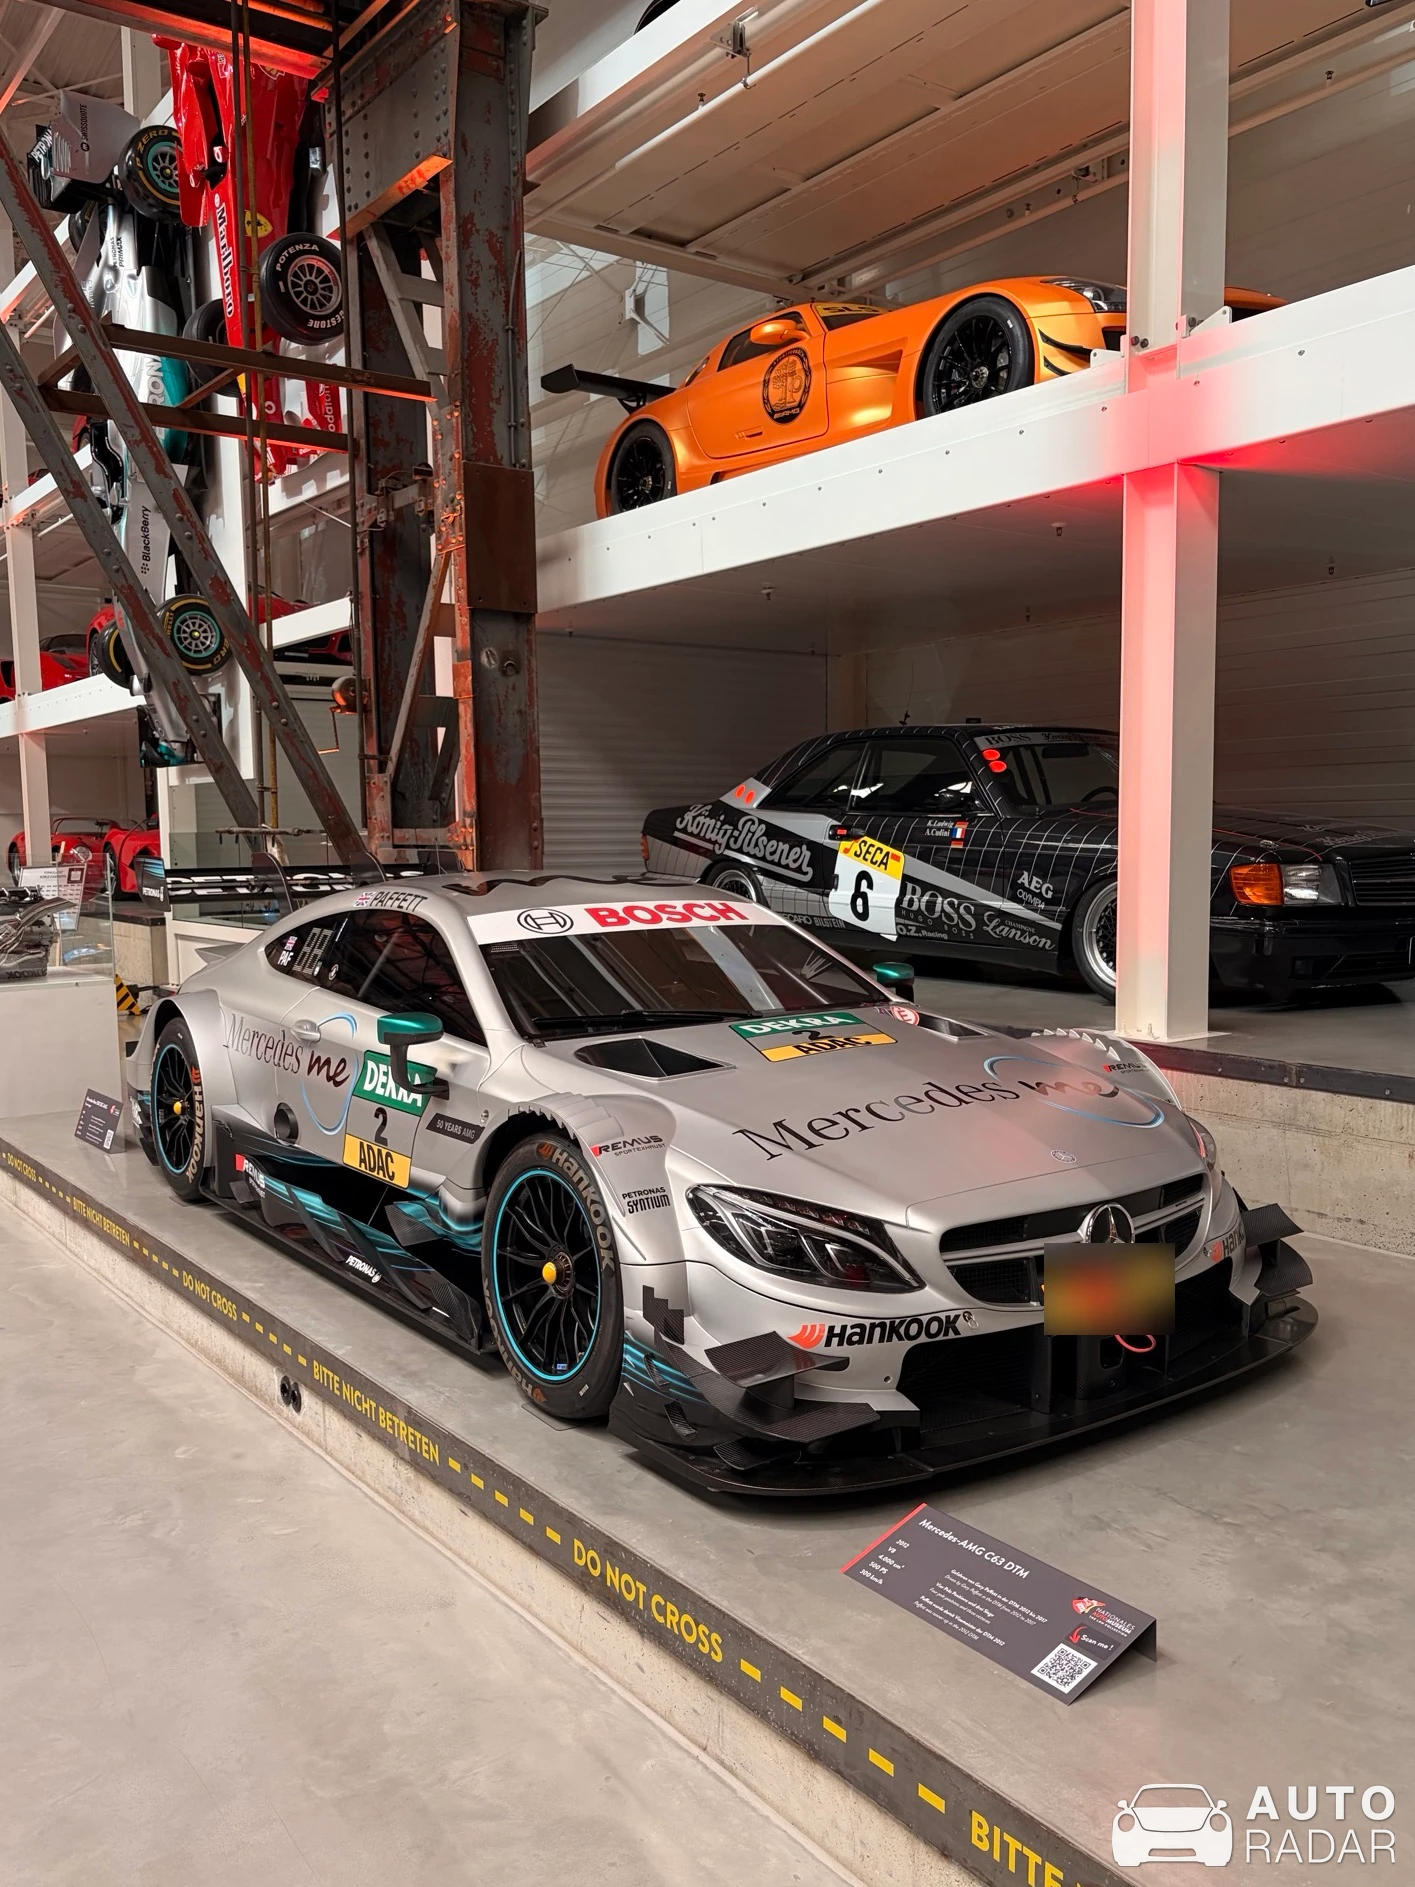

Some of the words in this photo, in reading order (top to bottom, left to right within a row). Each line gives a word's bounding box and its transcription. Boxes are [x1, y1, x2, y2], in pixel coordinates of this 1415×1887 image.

[138, 129, 168, 154] ZERO
[216, 202, 235, 318] Marlboro
[276, 243, 320, 271] POTENZA
[140, 505, 151, 562] BlackBerry
[985, 733, 1031, 746] BOSS
[854, 839, 891, 871] SECA
[142, 886, 160, 898] PETRONAS
[850, 870, 874, 922] 6
[1017, 870, 1053, 899] AEG
[369, 891, 428, 912] PAFFETT
[900, 882, 976, 931] BOSS
[1017, 889, 1046, 910] OLYMPIA
[584, 902, 750, 928] BOSCH
[813, 916, 846, 929] BILSTEIN
[901, 911, 933, 926] HUGO
[944, 925, 974, 940] BOSS
[983, 911, 1056, 950] Lanson
[277, 950, 294, 967] PAF
[739, 1015, 856, 1034] DEKRA
[792, 1030, 833, 1041] 2
[223, 1013, 304, 1074] Mercedes
[307, 1050, 350, 1087] me
[791, 1037, 873, 1055] ADAC
[373, 1107, 389, 1146] 2
[436, 1119, 444, 1129] 50
[444, 1121, 463, 1135] YEARS
[462, 1127, 476, 1140] AMG
[731, 1081, 1021, 1161] Mercedes
[1017, 1079, 1120, 1099] me
[598, 1135, 663, 1155] REMUS
[614, 1143, 666, 1157] SPORTEXHAUST
[7, 1152, 14, 1166] DO
[14, 1156, 23, 1175] NOT
[23, 1163, 37, 1182] CROSS
[243, 1158, 265, 1189] REMUS
[358, 1141, 396, 1182] ADAC
[621, 1186, 666, 1200] PETRONAS
[627, 1194, 671, 1214] SYNTIUM
[73, 1197, 87, 1217] BITTE
[87, 1205, 103, 1229] NICHT
[103, 1217, 130, 1247] BETRETEN
[345, 1255, 376, 1278] PETRONAS
[183, 1270, 194, 1291] DO
[194, 1277, 211, 1303] NOT
[211, 1291, 237, 1321] CROSS
[313, 1360, 340, 1396] BITTE
[342, 1380, 377, 1422] NICHT
[378, 1406, 440, 1467] BETRETEN
[896, 1539, 910, 1549] 2012
[919, 1518, 986, 1556] Mercedes-AMG
[984, 1551, 1006, 1567] C63
[1003, 1561, 1030, 1579] DTM
[869, 1561, 881, 1570] 500
[879, 1566, 888, 1574] PS
[573, 1538, 601, 1577] DO
[606, 1559, 647, 1610] NOT
[651, 1594, 723, 1663] CROSS
[974, 1581, 984, 1591] Gary
[1008, 1600, 1020, 1609] DTM
[1018, 1605, 1030, 1615] 2012
[1035, 1614, 1048, 1624] 2017
[991, 1599, 1002, 1608] DTM
[1092, 1611, 1132, 1634] AUTOMUSEUM
[1095, 1607, 1136, 1631] NATIONALES
[982, 1631, 994, 1641] DTM
[993, 1636, 1006, 1646] 2012
[1080, 1634, 1097, 1645] Scan
[1097, 1641, 1109, 1650] me
